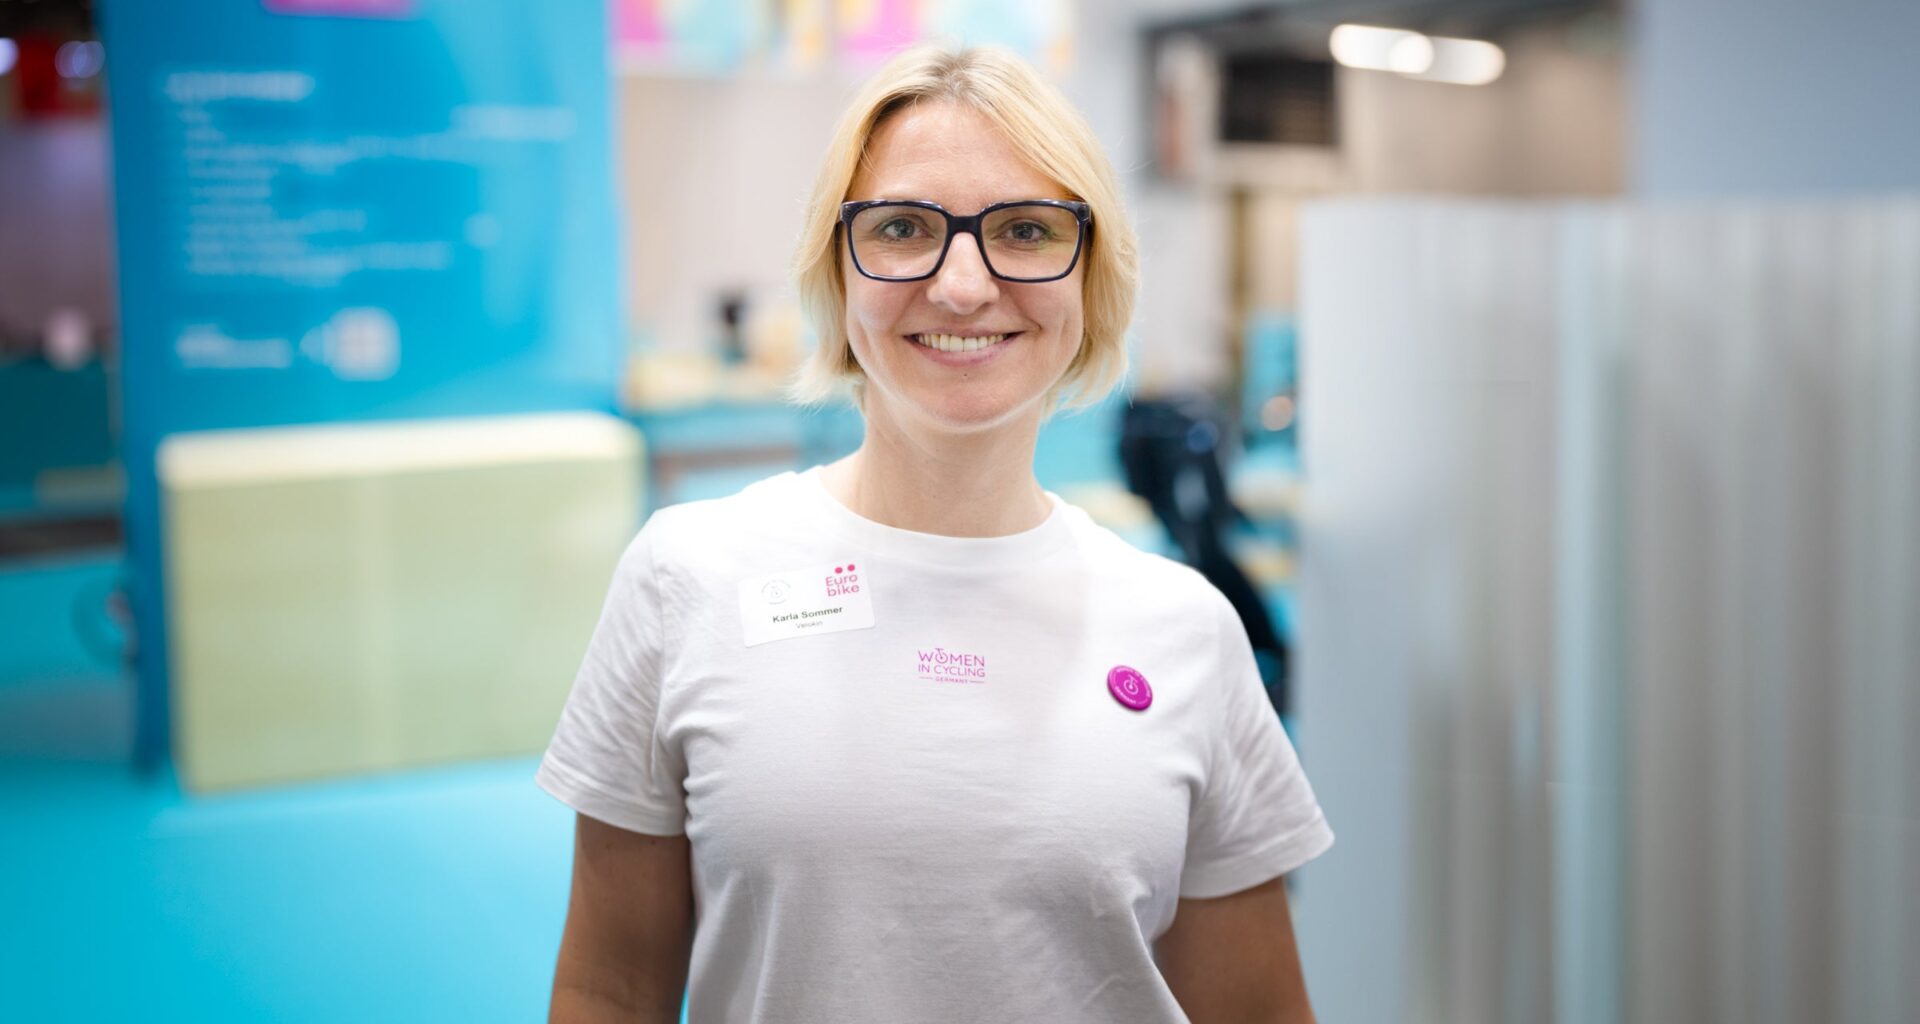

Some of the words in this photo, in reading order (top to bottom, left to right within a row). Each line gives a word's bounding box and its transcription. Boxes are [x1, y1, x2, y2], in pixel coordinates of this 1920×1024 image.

[827, 583, 860, 597] bike
[772, 611, 799, 623] Karla
[801, 606, 843, 619] Sommer
[918, 648, 985, 667] WOMEN
[918, 664, 930, 673] IN
[934, 665, 986, 678] CYCLING
[935, 676, 968, 684] GERMANY
